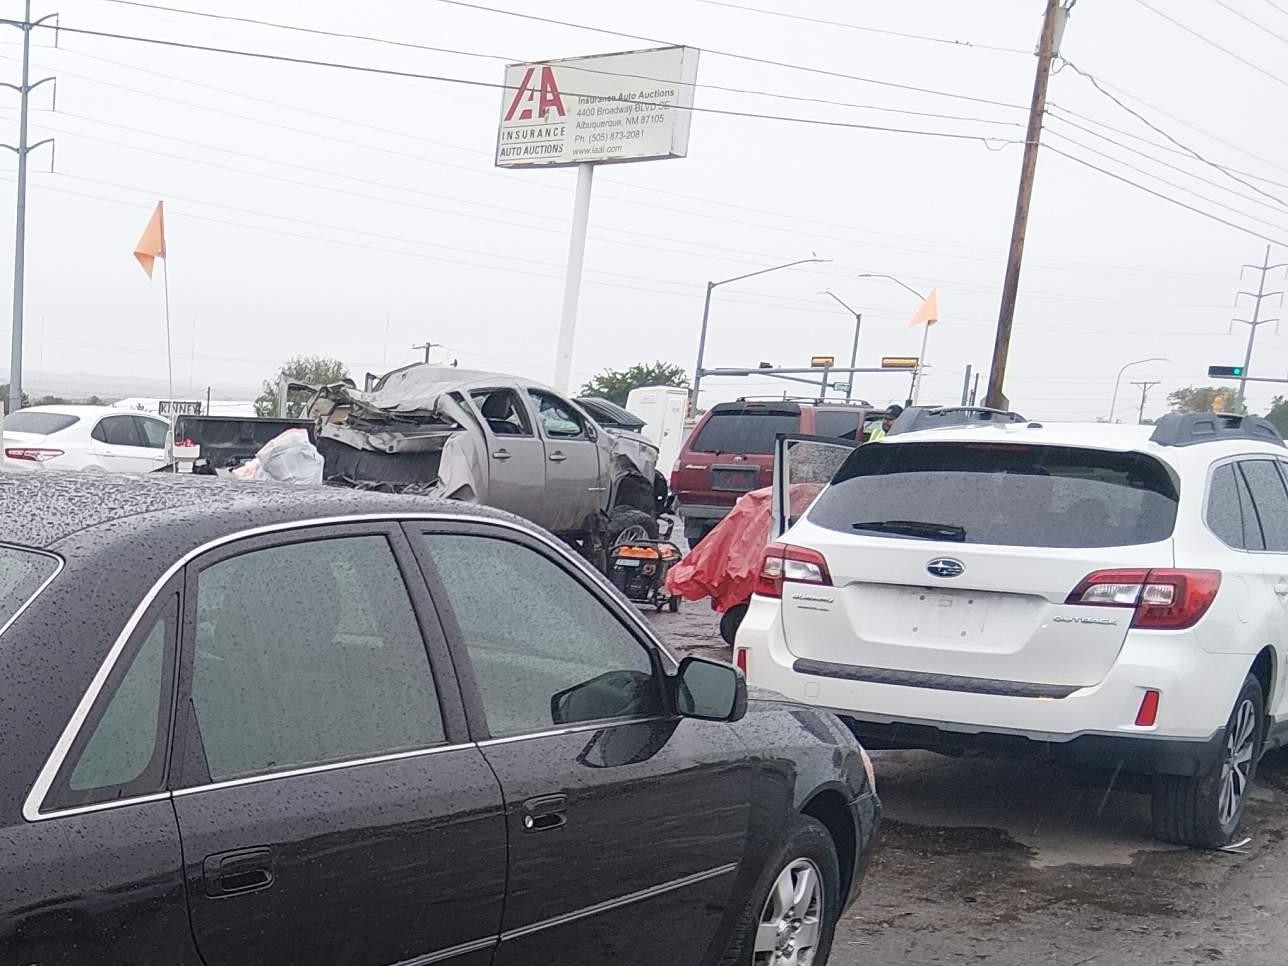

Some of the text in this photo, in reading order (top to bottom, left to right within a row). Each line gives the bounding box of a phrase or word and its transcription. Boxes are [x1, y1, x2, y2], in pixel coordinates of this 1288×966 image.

[577, 88, 675, 105] Insurance Auto Auctions
[576, 107, 595, 117] 4400
[596, 104, 633, 116] Broadway
[634, 102, 656, 113] BLVD
[575, 113, 664, 131] Albuquerque, NM 87105
[501, 126, 566, 140] INSURANCE
[588, 132, 608, 144] (505)
[499, 143, 564, 157] AUTO AUCTIONS
